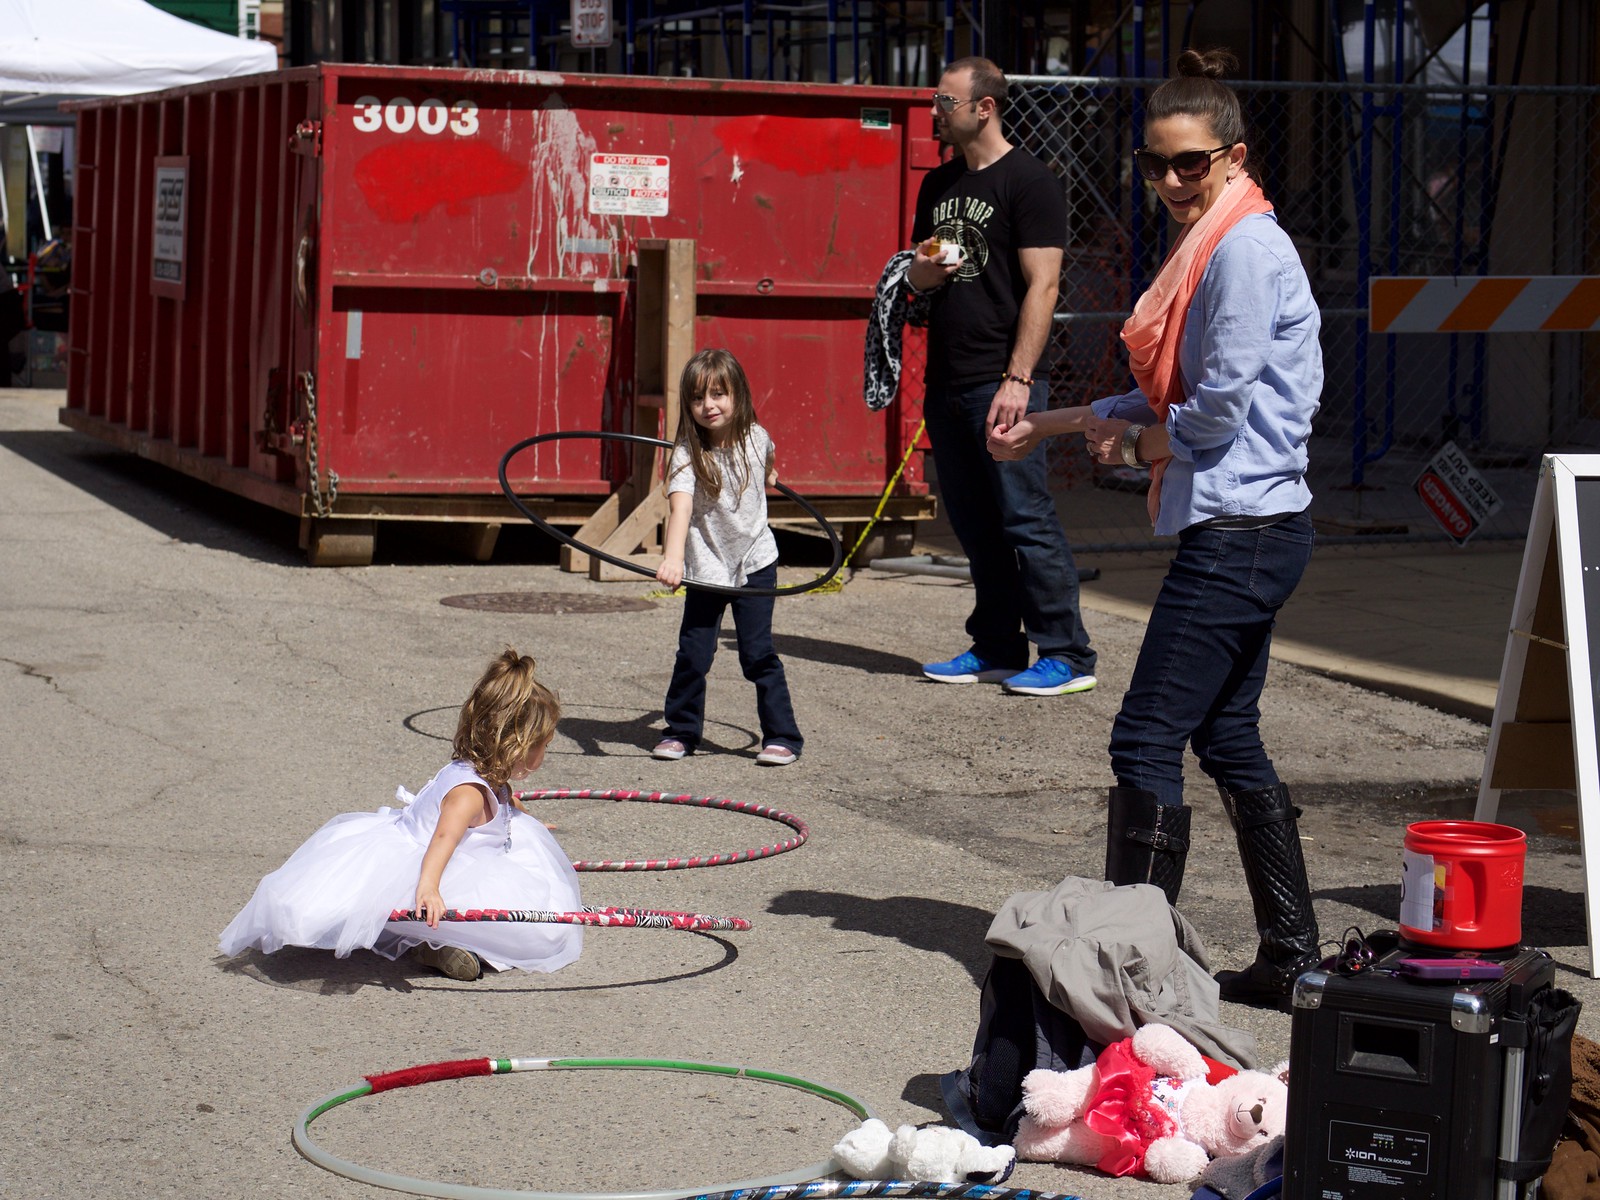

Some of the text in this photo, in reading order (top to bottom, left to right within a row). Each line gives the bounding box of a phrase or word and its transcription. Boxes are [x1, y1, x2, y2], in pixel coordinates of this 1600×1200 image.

[578, 13, 606, 29] STOP
[353, 95, 480, 136] 3003
[603, 155, 658, 166] DO NOT PARK
[633, 189, 665, 198] NOTICE
[1437, 459, 1488, 519] CONSTRUCTION AREA
[1447, 452, 1496, 507] KEEP OUT
[1423, 478, 1469, 533] DANGER
[1393, 1158, 1411, 1166] ROCKER
